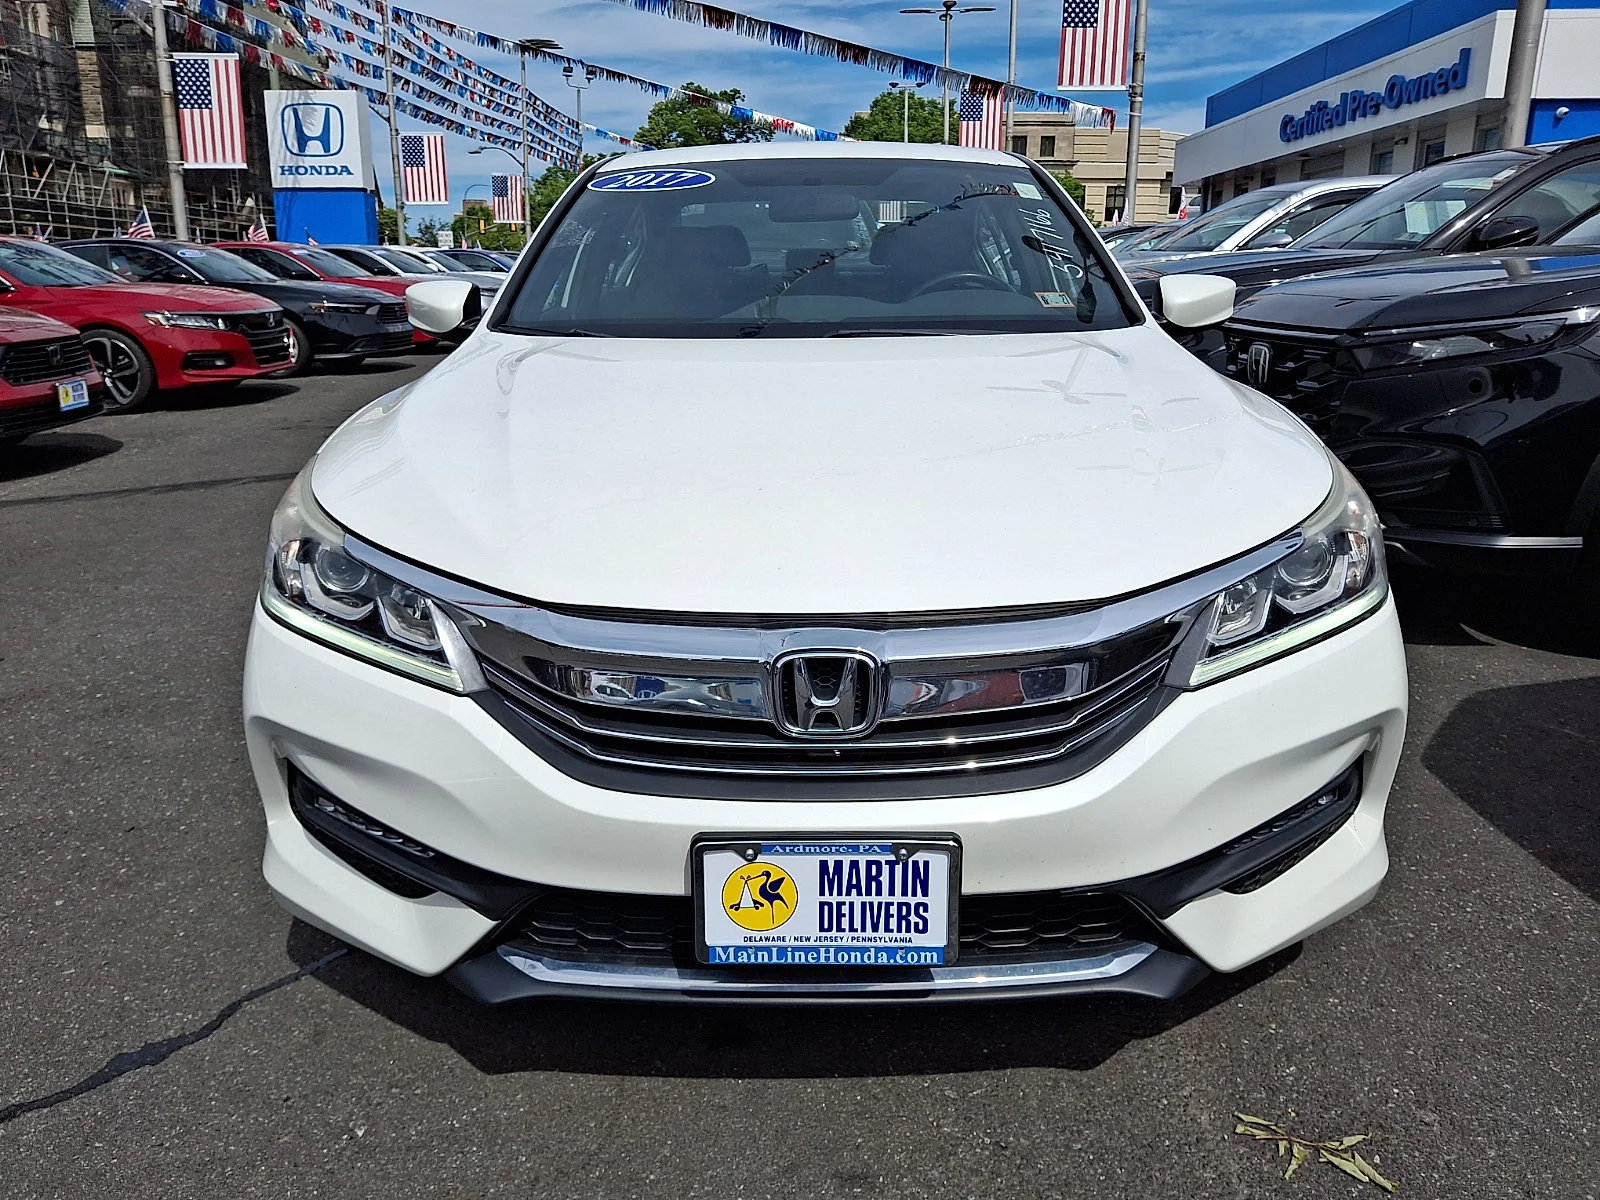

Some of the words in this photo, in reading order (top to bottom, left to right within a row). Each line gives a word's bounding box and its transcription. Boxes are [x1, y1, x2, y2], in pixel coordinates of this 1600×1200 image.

[1279, 92, 1349, 142] Certified
[1348, 47, 1472, 122] Pre-Owned
[279, 165, 354, 176] HONDA
[602, 172, 701, 189] 2017
[859, 844, 882, 854] PA
[818, 859, 930, 898] MARTIN
[818, 901, 929, 935] DELIVERS
[743, 935, 787, 943] DELAWARE
[793, 935, 812, 943] NEW
[813, 935, 844, 943] JERSEY
[850, 935, 913, 944] PENNSYLVANIA
[714, 946, 938, 965] MainLineHonda.com
